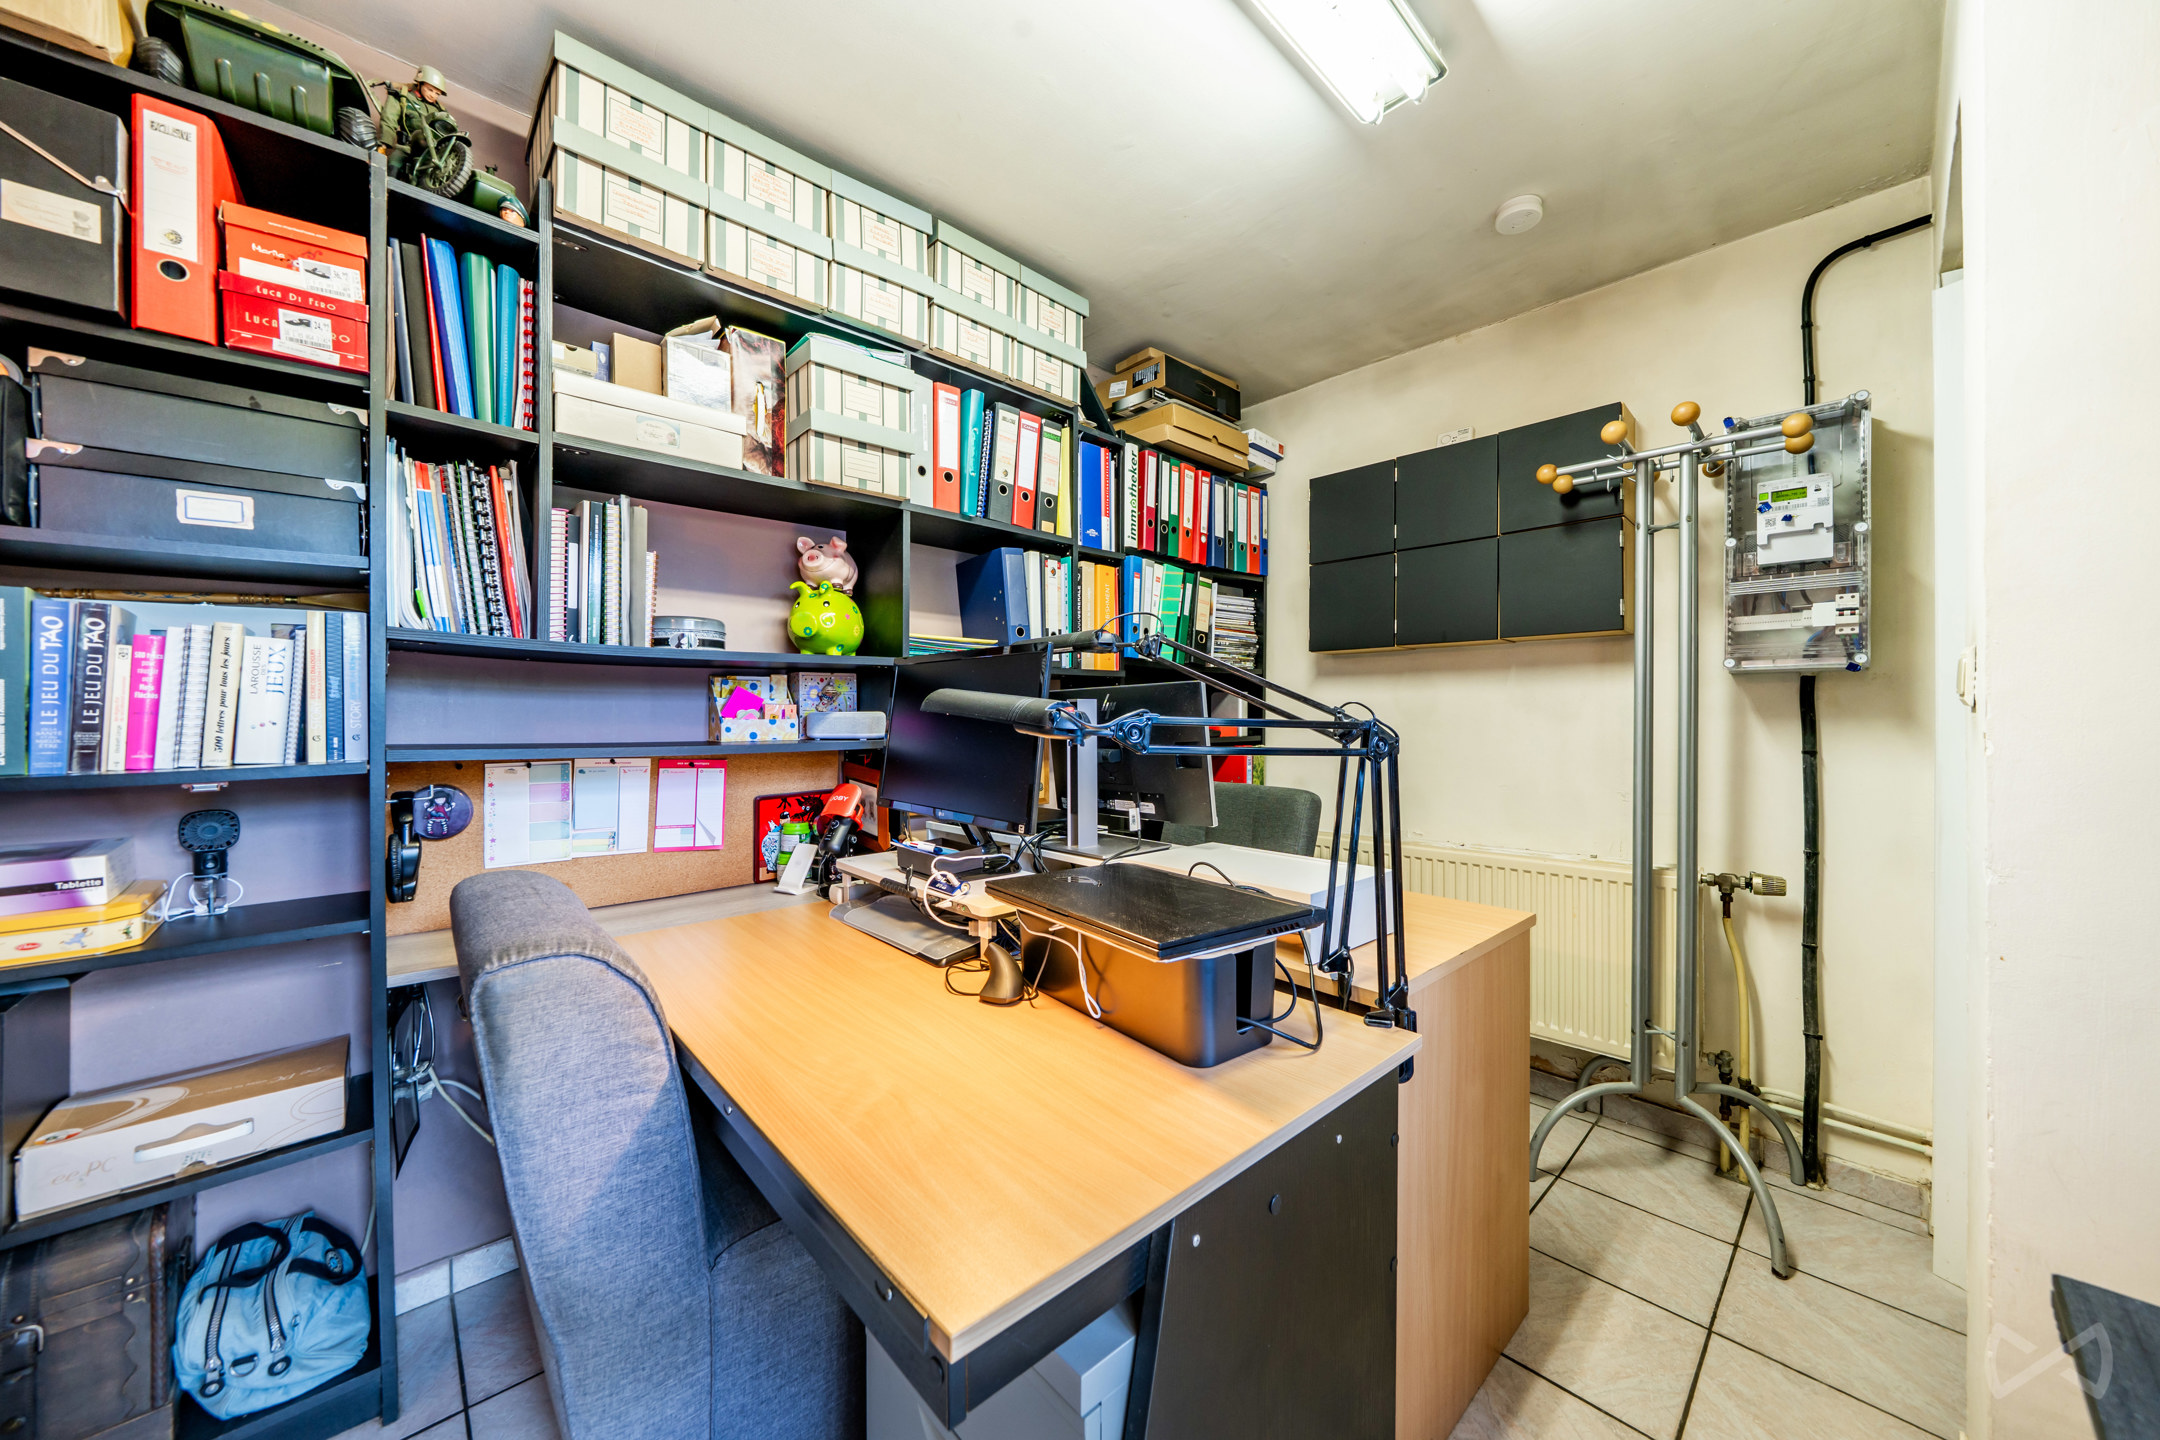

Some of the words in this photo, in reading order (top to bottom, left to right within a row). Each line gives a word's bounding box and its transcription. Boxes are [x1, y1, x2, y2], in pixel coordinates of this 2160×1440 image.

[331, 332, 350, 343] RO
[40, 616, 64, 650] TAO
[82, 617, 106, 650] TAO
[42, 652, 60, 675] DU
[86, 654, 104, 676] DU
[250, 644, 261, 695] LAROUSSE
[266, 646, 286, 696] JEUX
[221, 671, 229, 688] tous
[41, 681, 61, 704] JEU
[84, 681, 104, 704] JEU
[219, 690, 228, 708] pour
[40, 710, 58, 725] LE
[82, 708, 100, 724] LE
[216, 711, 225, 734] lettres
[350, 700, 362, 728] STORY
[214, 736, 224, 752] 500
[54, 878, 102, 890] Tablette
